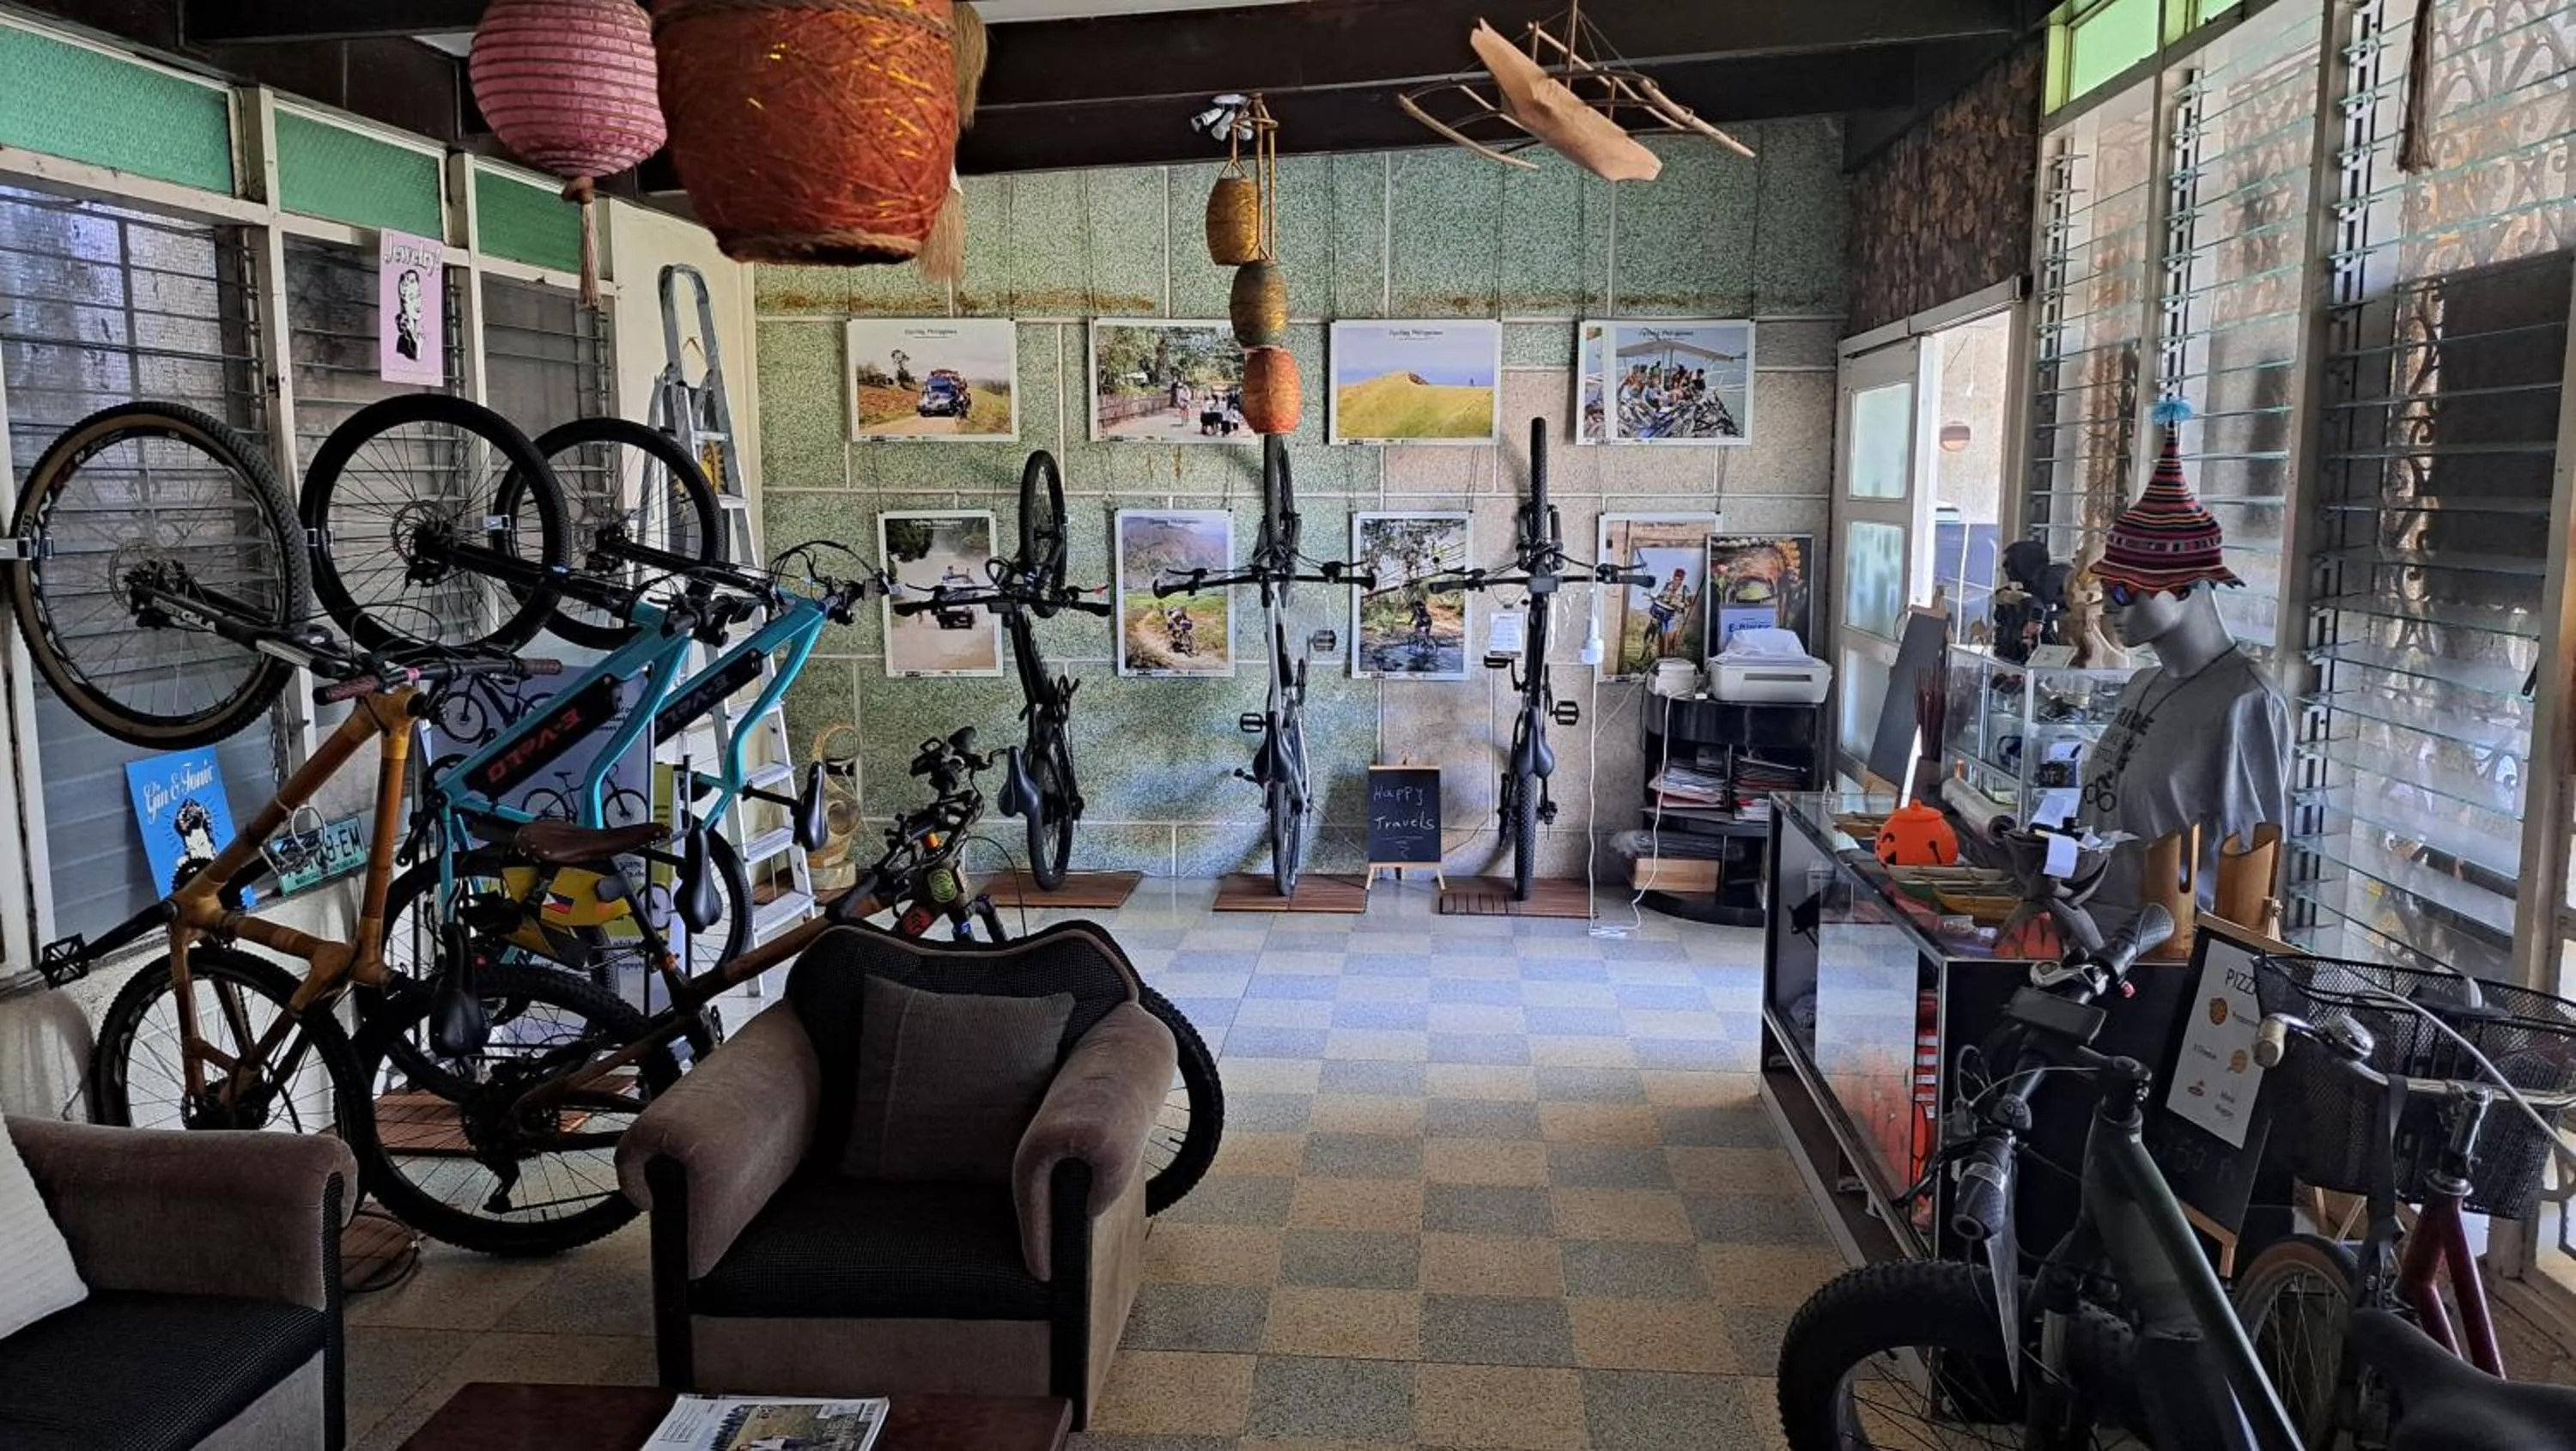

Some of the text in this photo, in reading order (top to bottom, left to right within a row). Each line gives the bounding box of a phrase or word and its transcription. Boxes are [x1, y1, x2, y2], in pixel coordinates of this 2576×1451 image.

[384, 233, 441, 276] Jewelry!
[143, 759, 213, 825] Gin & Tonic
[1373, 810, 1436, 832] Travels
[2225, 968, 2255, 996] PIZZ
